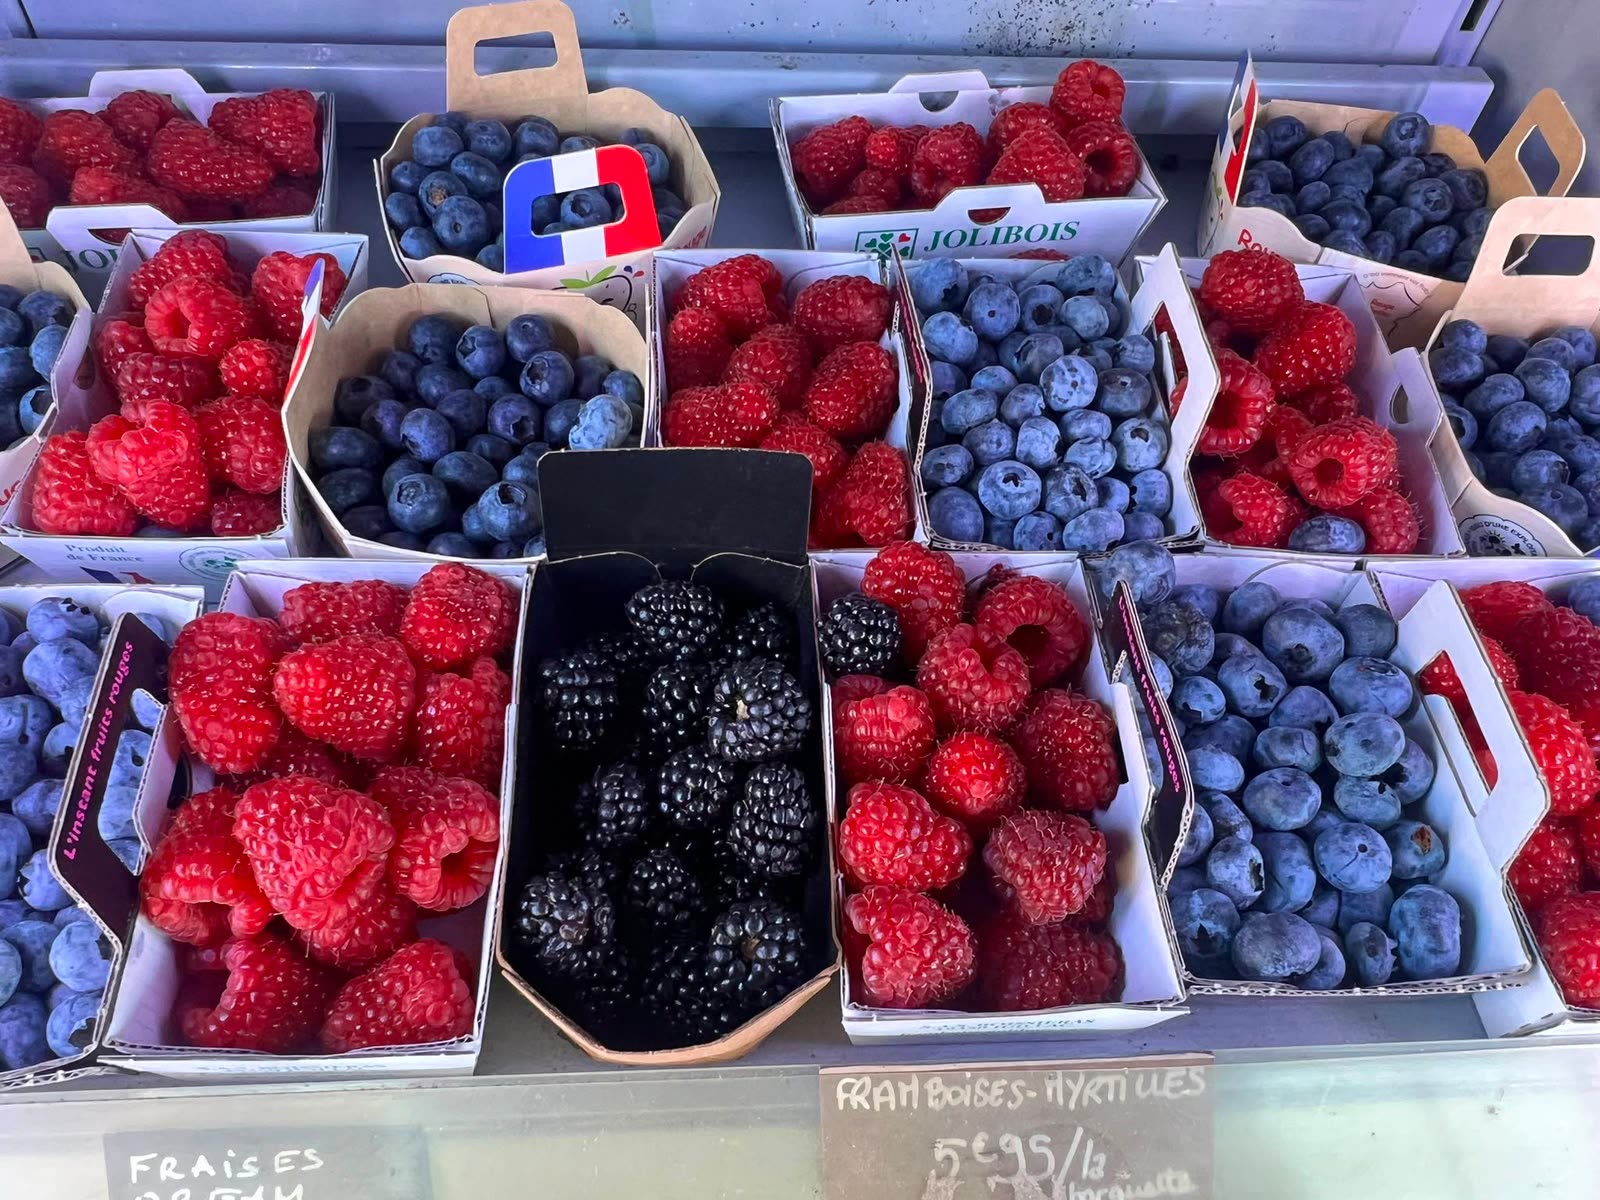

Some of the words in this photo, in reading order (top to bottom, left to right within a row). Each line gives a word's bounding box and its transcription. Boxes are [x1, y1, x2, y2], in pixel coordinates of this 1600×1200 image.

[924, 220, 1081, 252] JOLIBOIS
[64, 544, 128, 553] Produit
[66, 553, 84, 561] de
[87, 553, 143, 561] France
[63, 764, 98, 861] L'instant
[91, 707, 113, 760] fruits
[108, 641, 134, 705] rouges
